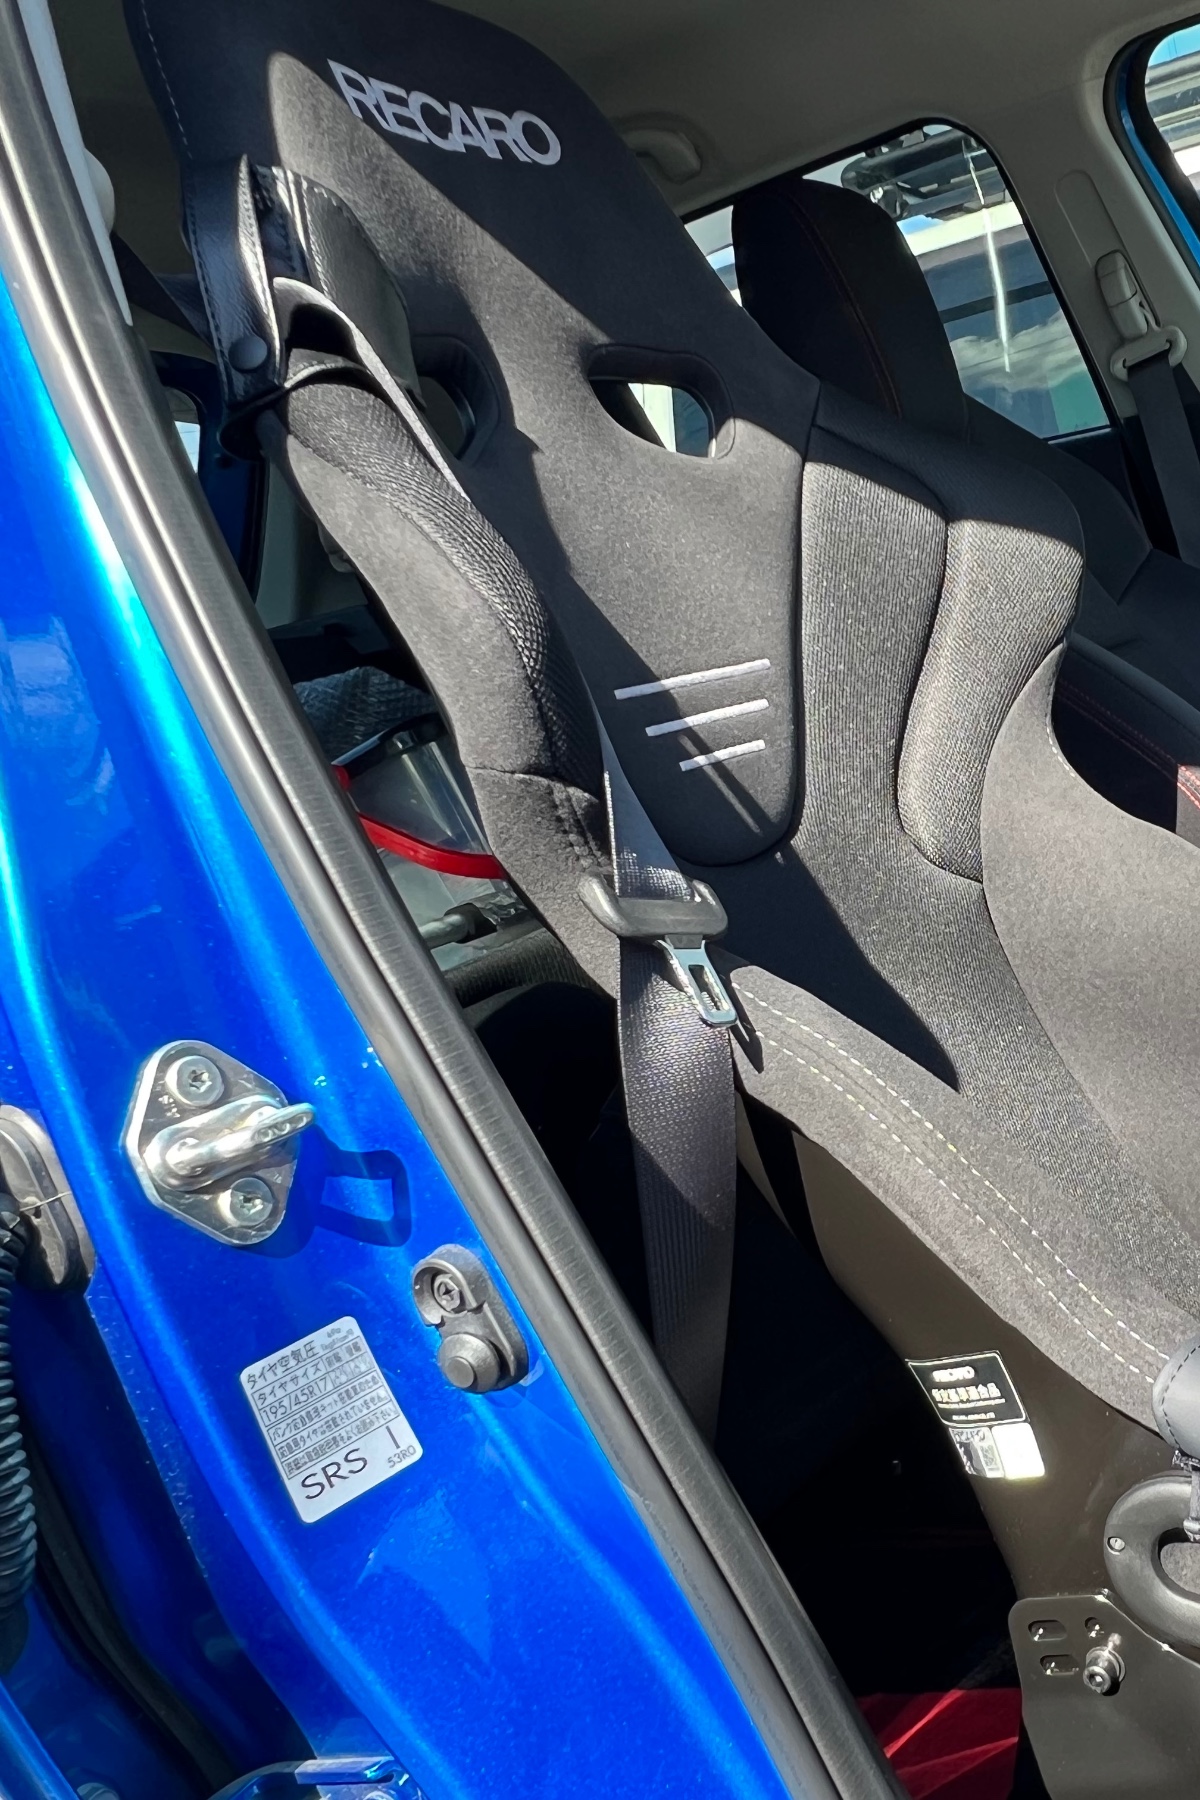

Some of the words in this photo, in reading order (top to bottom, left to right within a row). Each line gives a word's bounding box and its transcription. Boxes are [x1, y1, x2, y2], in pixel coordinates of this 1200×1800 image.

[326, 58, 562, 166] RECARO
[247, 1340, 319, 1390] タイヤ空気圧
[257, 1363, 323, 1405] タイヤサイズ
[263, 1378, 327, 1422] 195/45R17
[301, 1448, 368, 1500] SRS
